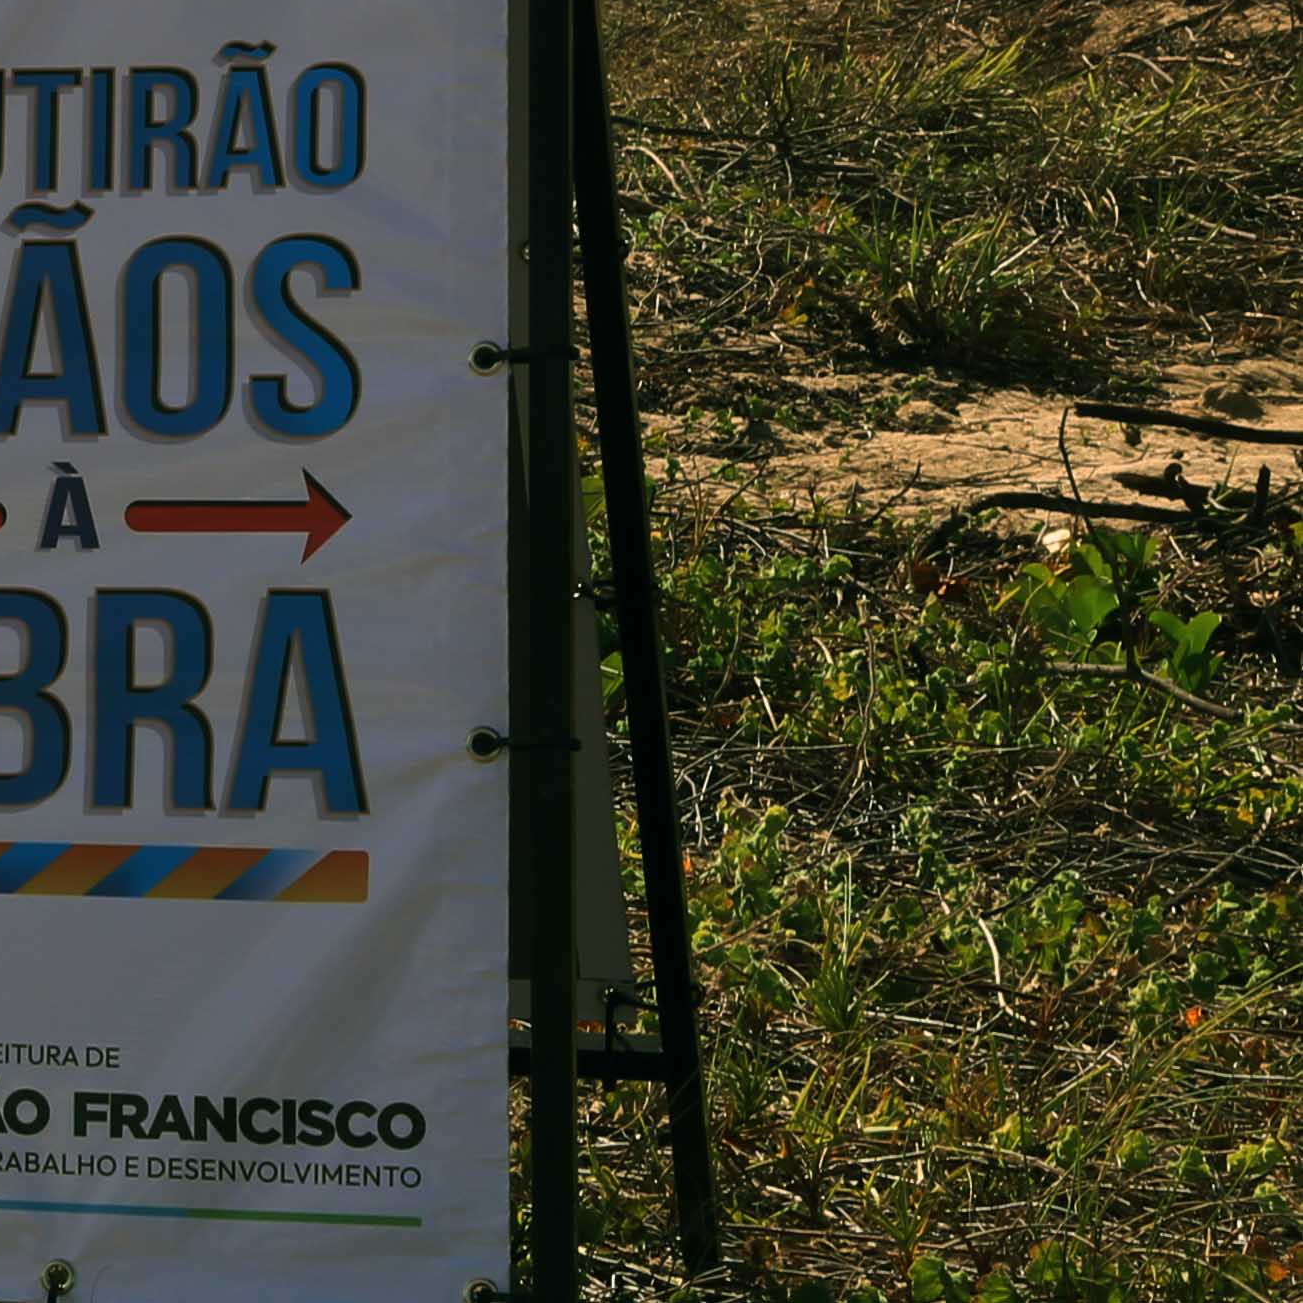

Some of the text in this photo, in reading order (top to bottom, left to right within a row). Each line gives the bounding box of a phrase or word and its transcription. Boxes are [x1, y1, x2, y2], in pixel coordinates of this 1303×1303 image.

[39, 462, 100, 551] À
[85, 1046, 120, 1069] DE
[73, 1091, 427, 1151] FRANCISCO
[124, 1155, 139, 1178] E
[147, 1156, 422, 1189] DESENVOLVIMENTO
